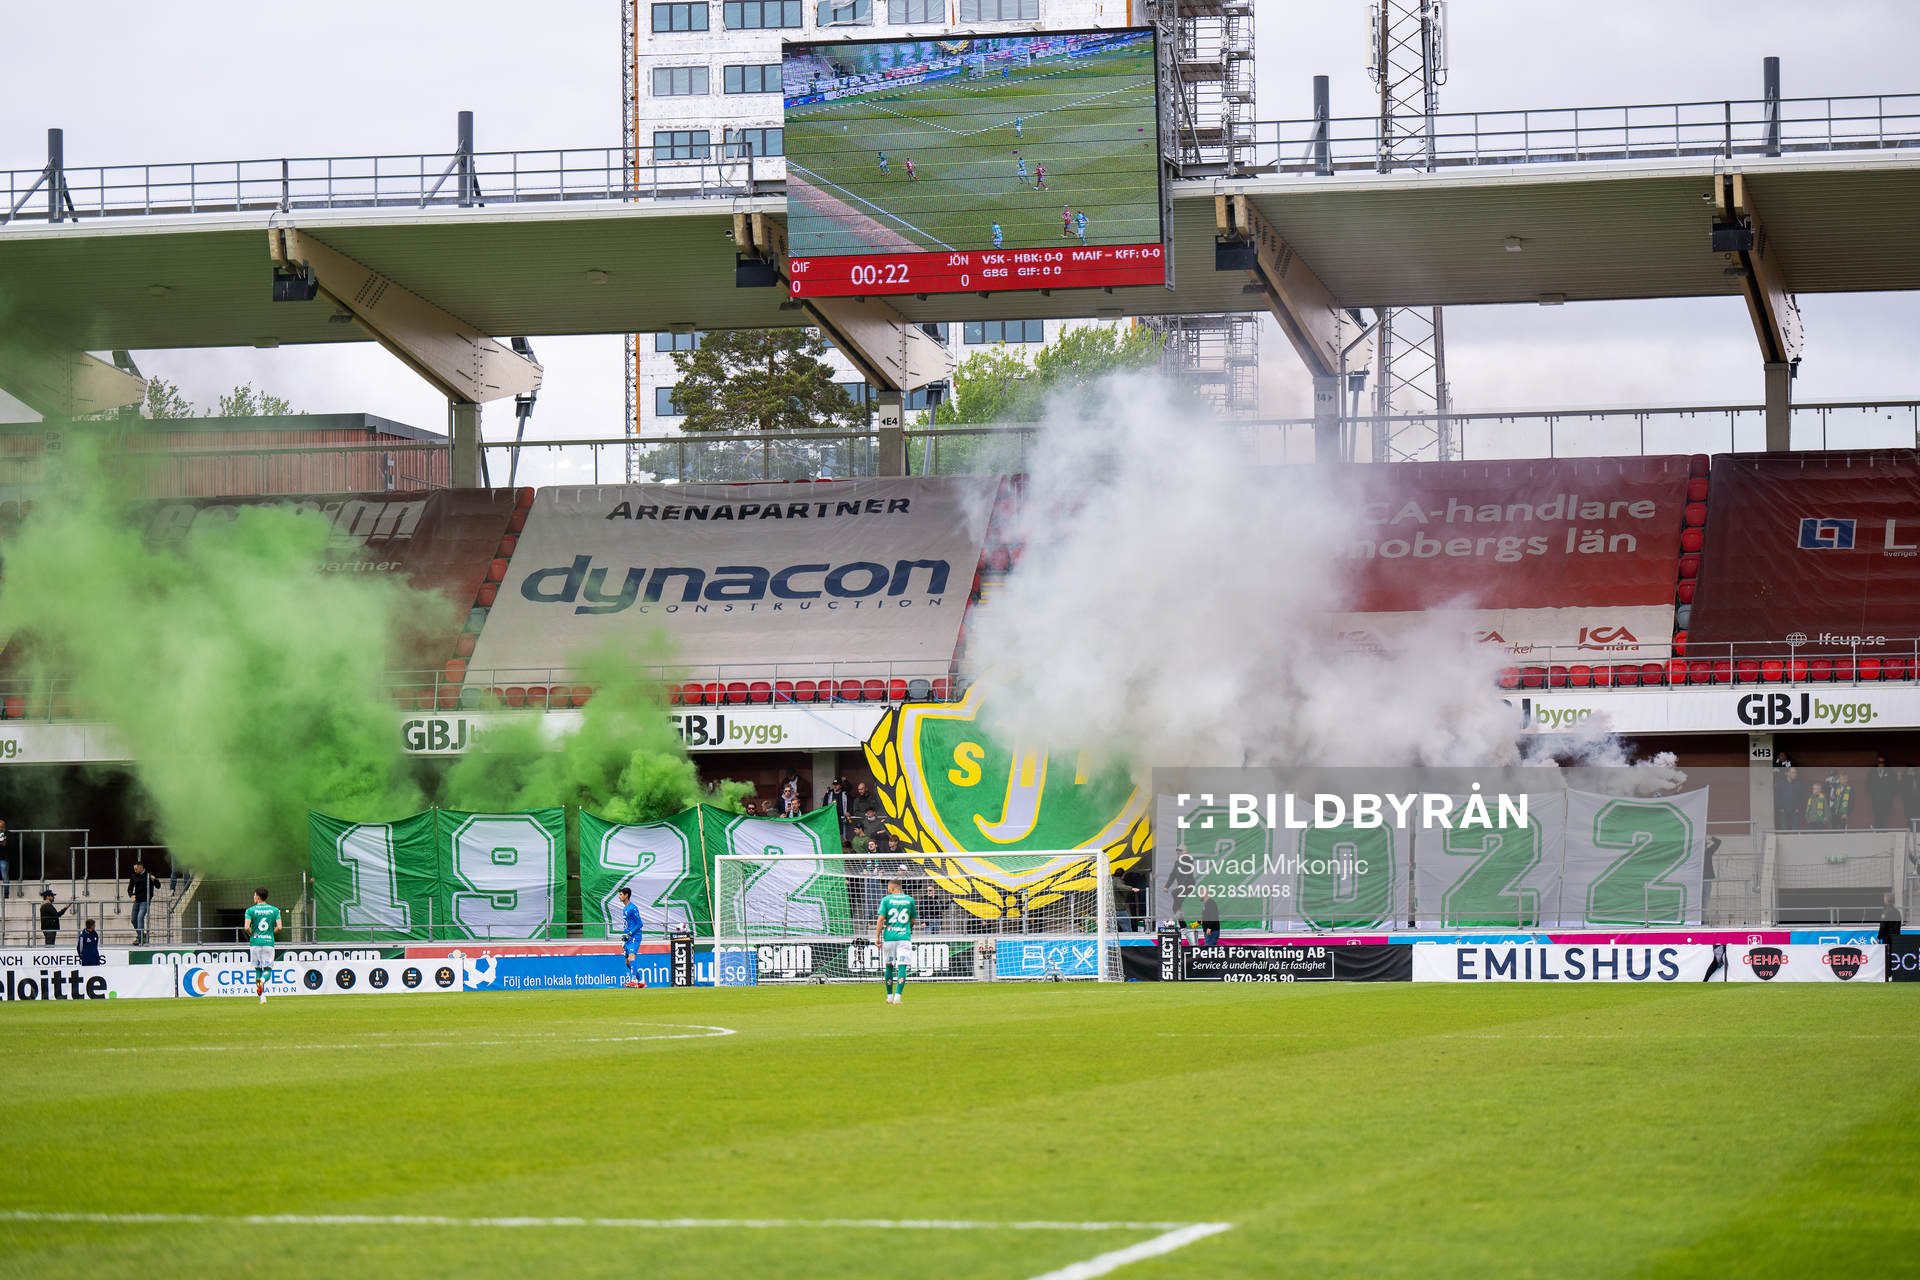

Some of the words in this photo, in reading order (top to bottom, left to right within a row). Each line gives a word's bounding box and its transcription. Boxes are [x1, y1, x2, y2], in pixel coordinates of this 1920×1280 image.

[947, 254, 969, 266] JÖN
[982, 254, 1006, 264] VSK
[1014, 253, 1042, 263] HBK:
[1044, 252, 1063, 262] 0-0
[1072, 250, 1103, 261] MAIF
[1115, 249, 1140, 259] KFF:
[1141, 248, 1161, 258] 0-0
[791, 261, 811, 273] ÖIF
[851, 264, 909, 285] 00:22
[792, 280, 801, 293] 0
[960, 274, 970, 287] 0
[886, 417, 898, 425] E4
[606, 498, 911, 521] ARENAPARTNER
[1358, 494, 1656, 525] CA-handlare
[1566, 527, 1637, 554] län
[519, 554, 951, 616] dynacon
[639, 598, 943, 614] CONSTRUCTION
[1578, 626, 1638, 643] ICA
[1736, 692, 1810, 726] GBJ
[1814, 698, 1879, 725] bygg.
[401, 719, 467, 751] GBJ
[728, 719, 789, 745] bygg.
[1757, 748, 1771, 758] H3
[888, 908, 909, 924] 26
[257, 917, 269, 932] 6
[33, 955, 107, 967] KONFERS
[1162, 937, 1174, 980] SELECT
[1192, 947, 1226, 959] PeHå
[1228, 946, 1304, 961] Förvaltning
[1307, 947, 1326, 958] AB
[1742, 954, 1789, 966] GEHAB
[1821, 954, 1869, 966] GEHAB
[674, 943, 687, 986] SELECT
[1192, 961, 1221, 970] Service
[1229, 960, 1267, 970] underhåll
[1269, 961, 1280, 972] på
[1290, 960, 1326, 972] fastighet
[1457, 947, 1680, 981] EMILSHUS
[217, 968, 297, 986] CREEC
[503, 975, 521, 988] Följ
[523, 975, 541, 986] den
[543, 974, 572, 986] lokala
[574, 974, 618, 985] fotbollen
[1223, 973, 1278, 982] 0470-285
[1280, 973, 1295, 982] 90
[217, 986, 297, 995] INSTALATION
